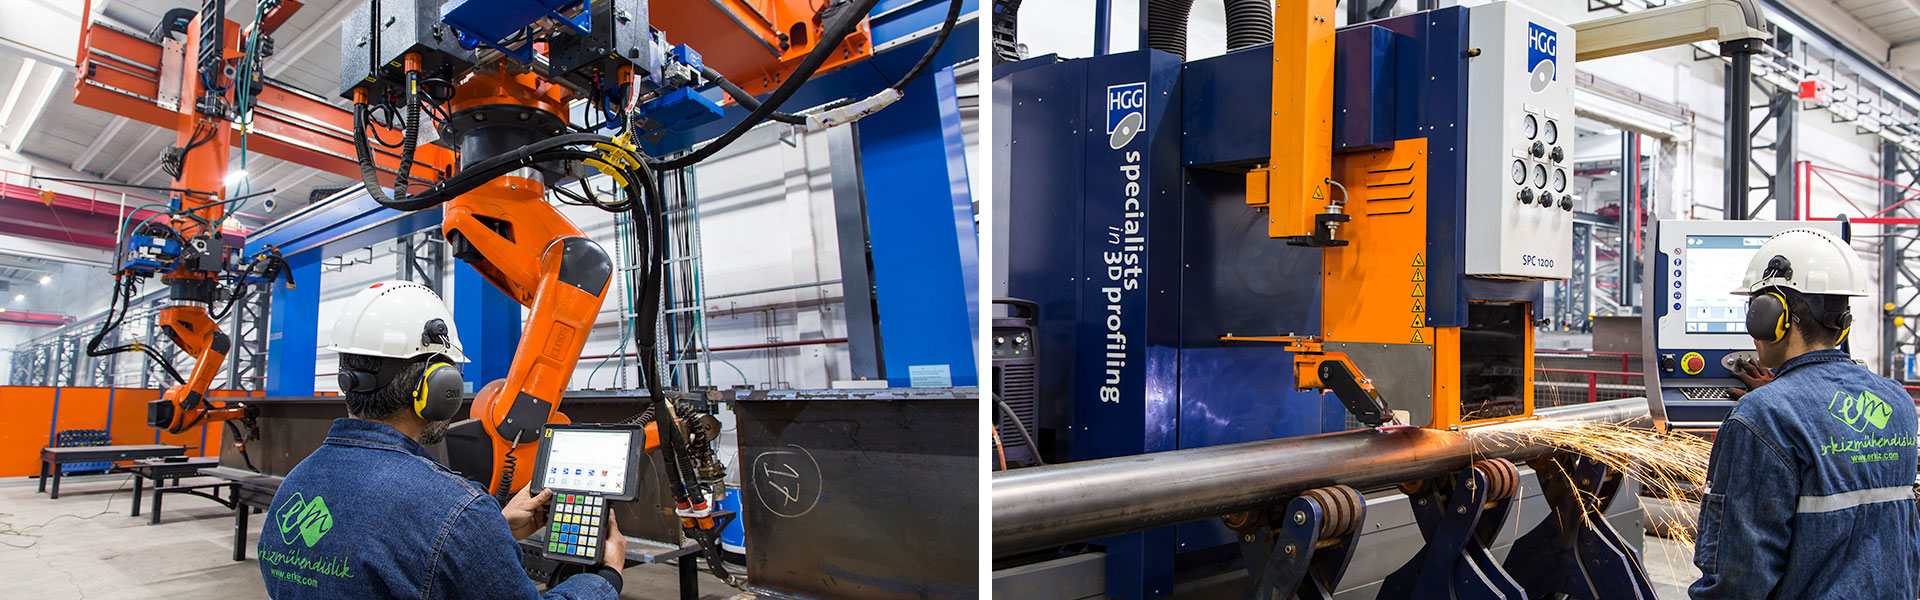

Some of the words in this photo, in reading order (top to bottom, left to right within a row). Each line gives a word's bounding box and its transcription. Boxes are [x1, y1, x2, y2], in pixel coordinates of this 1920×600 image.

[1529, 27, 1556, 57] HGG
[1110, 89, 1144, 111] HGG
[1108, 225, 1124, 245] in
[1119, 150, 1145, 290] specialists
[1103, 251, 1123, 281] 3D
[1522, 254, 1536, 266] SPC
[1537, 258, 1555, 268] 1200
[1099, 287, 1127, 404] profiling
[1850, 452, 1899, 463] www.erkiz.com
[258, 541, 354, 578] rkizmühendislik
